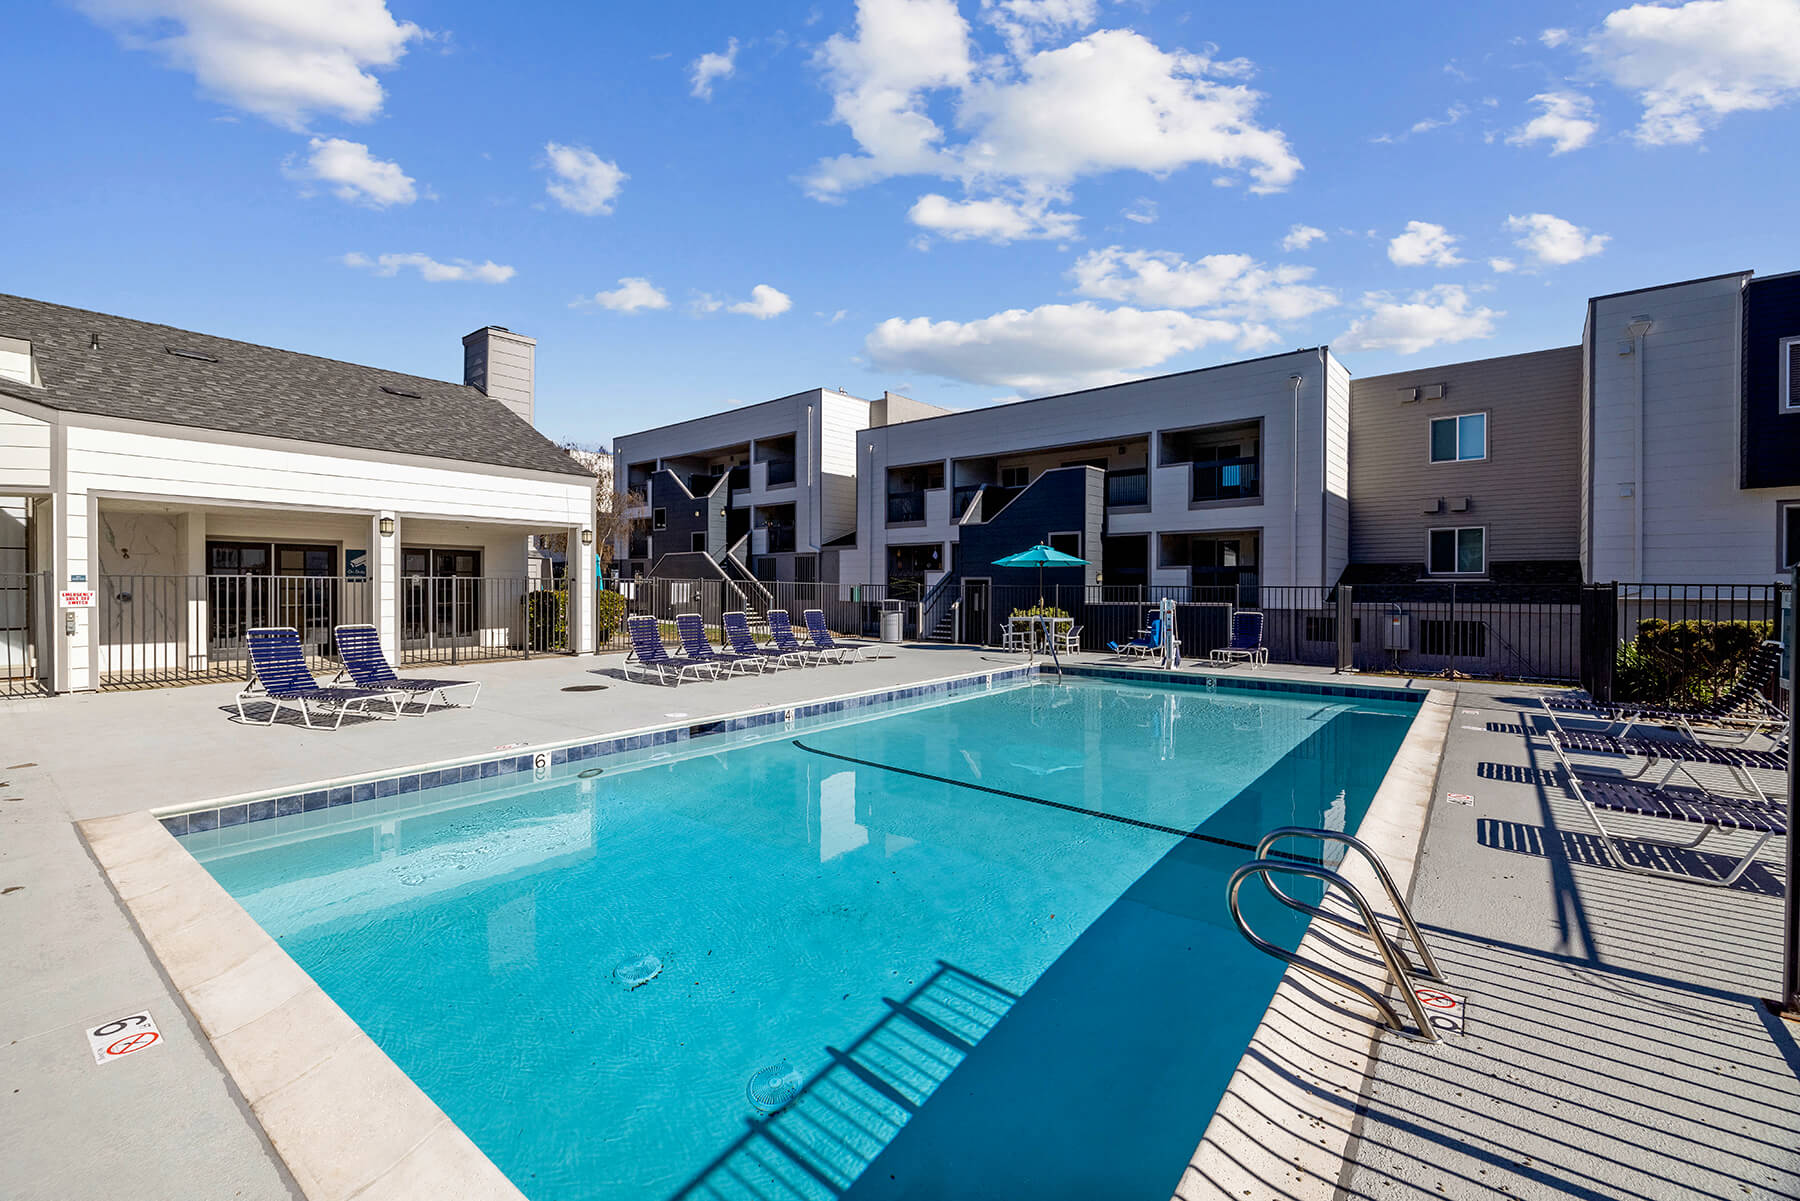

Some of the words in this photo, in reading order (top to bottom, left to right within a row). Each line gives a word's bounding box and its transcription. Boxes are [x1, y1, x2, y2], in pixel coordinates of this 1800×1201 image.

[785, 709, 791, 721] 4
[535, 753, 546, 769] 6
[93, 1015, 148, 1037] 6
